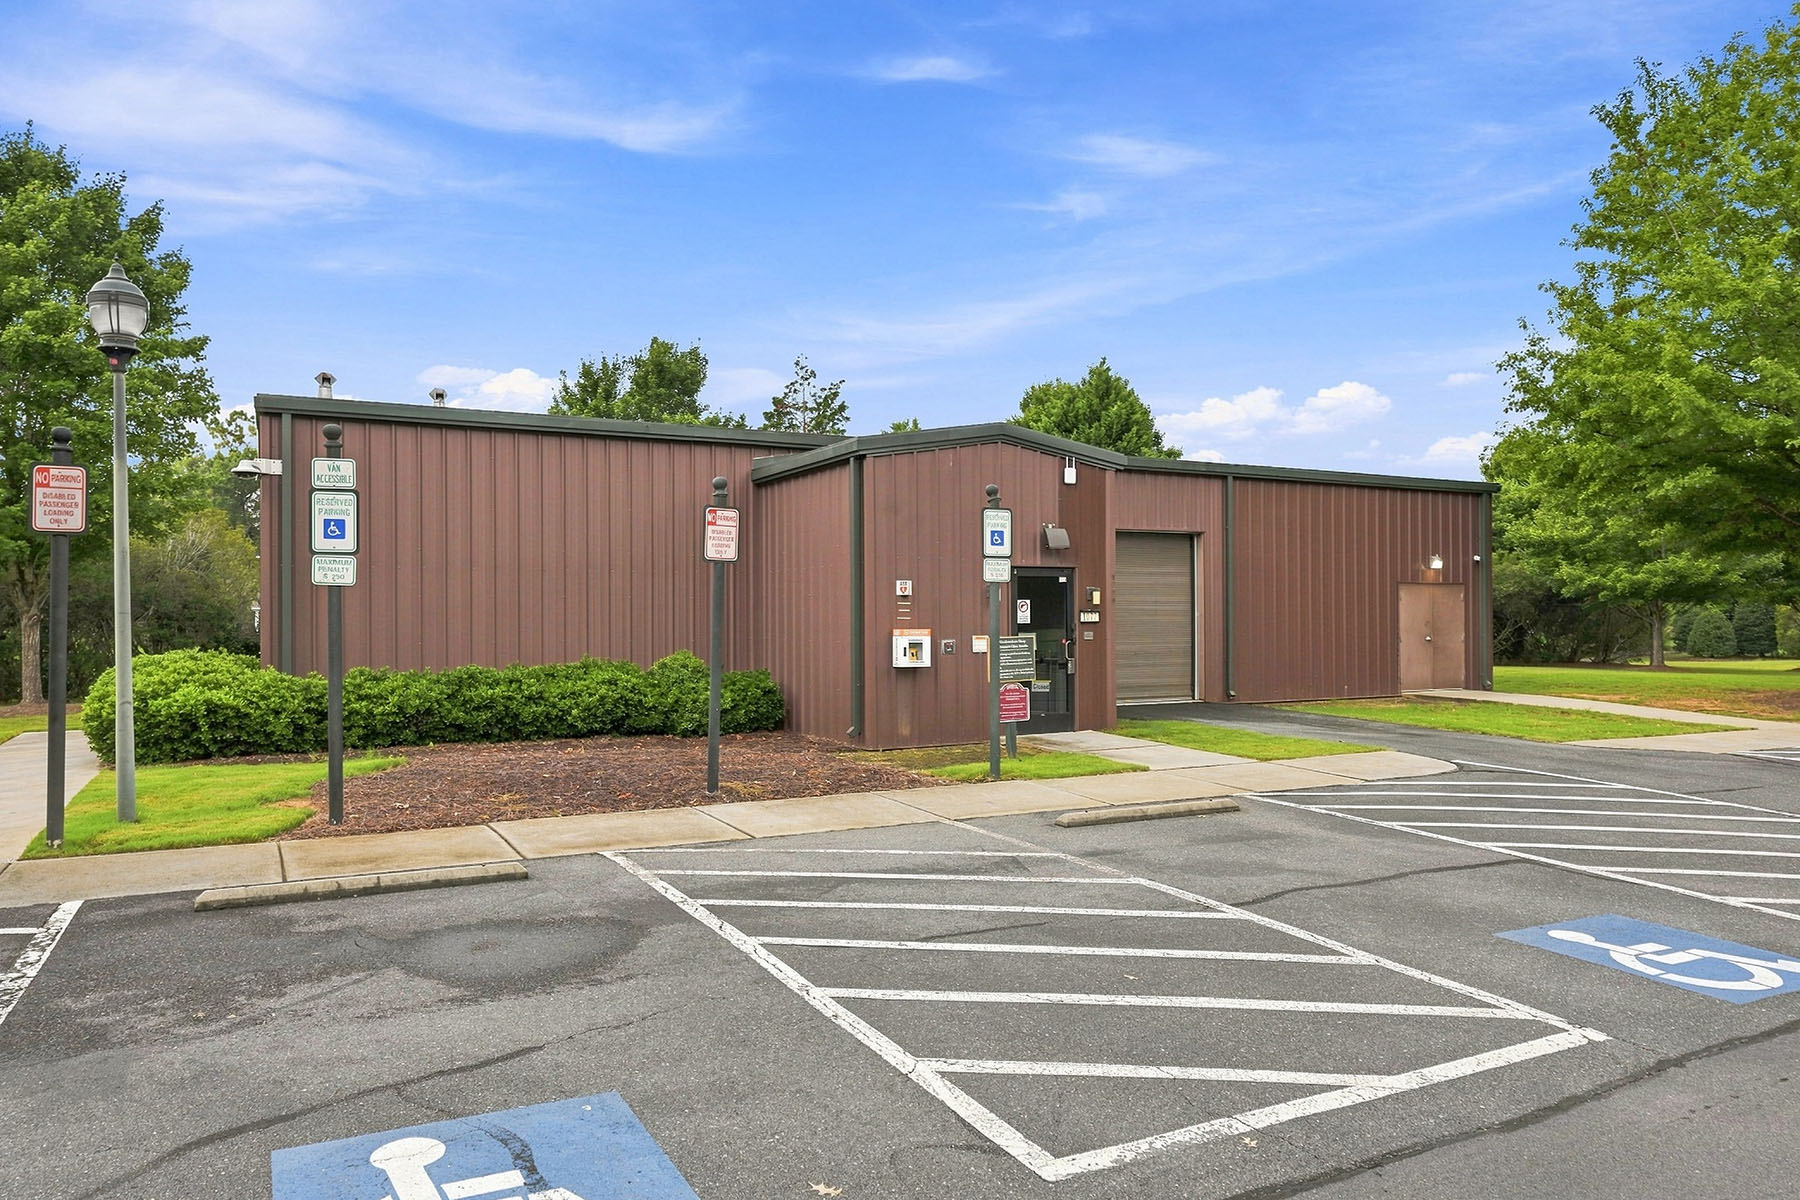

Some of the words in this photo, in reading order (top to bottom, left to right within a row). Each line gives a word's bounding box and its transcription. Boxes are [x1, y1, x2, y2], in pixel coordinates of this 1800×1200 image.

[327, 463, 341, 472] VAN
[36, 471, 49, 484] NO
[51, 474, 81, 484] PARKING
[316, 474, 352, 484] ACCESSIBLE
[42, 492, 76, 500] DISABLED
[39, 500, 79, 508] PASSENGER
[316, 497, 353, 506] RESERVED
[43, 509, 74, 517] LOADING
[318, 507, 351, 516] PARKING
[707, 512, 716, 522] NO
[717, 514, 736, 523] PARKING
[316, 558, 353, 566] MAXIMUM
[317, 565, 350, 573] PENALTY
